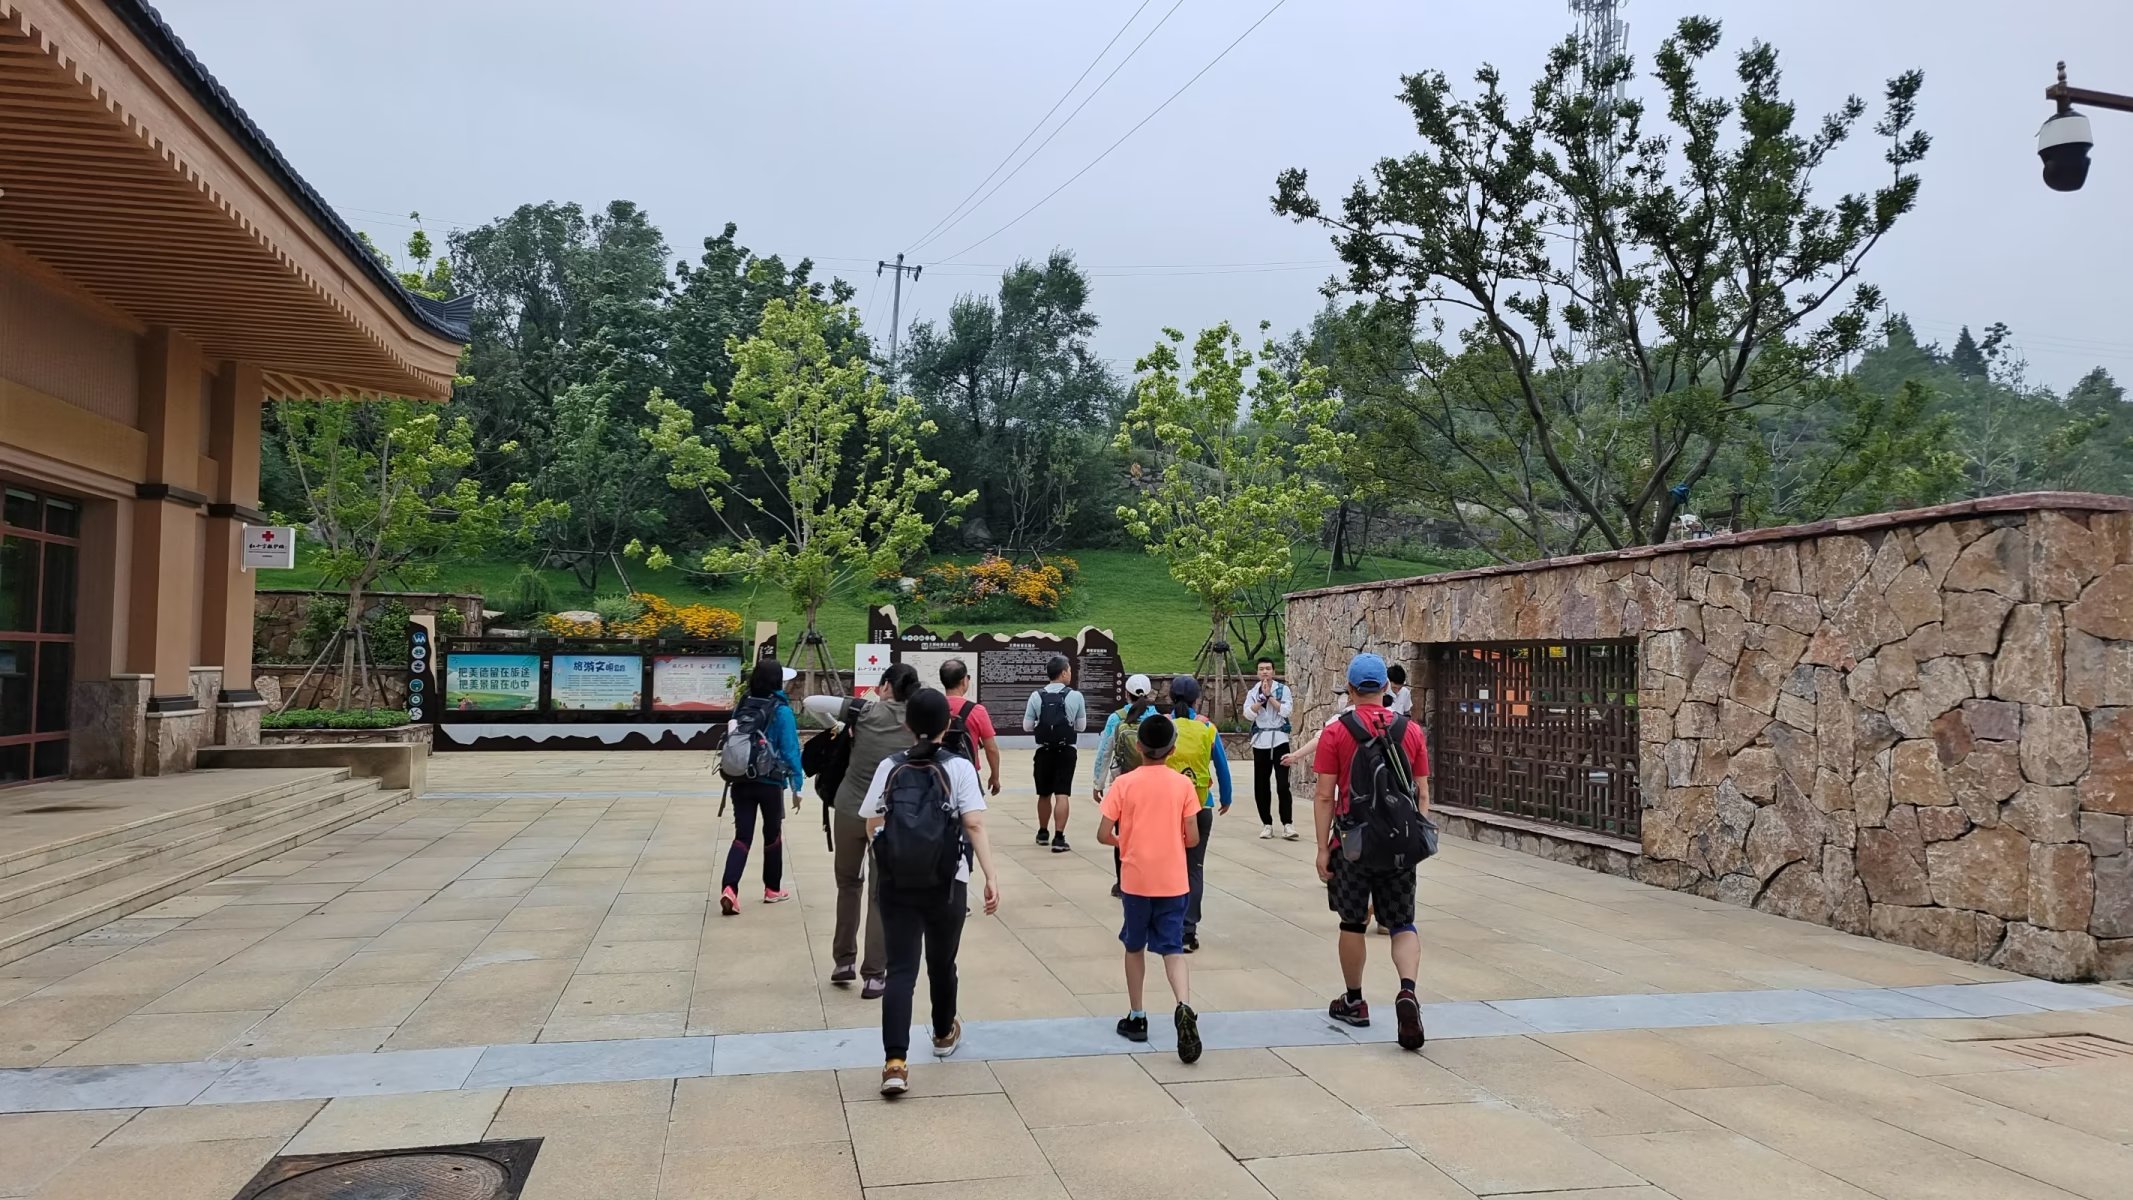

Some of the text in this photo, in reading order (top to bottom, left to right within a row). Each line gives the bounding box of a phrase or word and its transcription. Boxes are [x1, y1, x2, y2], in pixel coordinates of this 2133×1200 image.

[458, 667, 530, 678] 把美德留在旅途
[458, 679, 530, 690] 把美景留在心中
